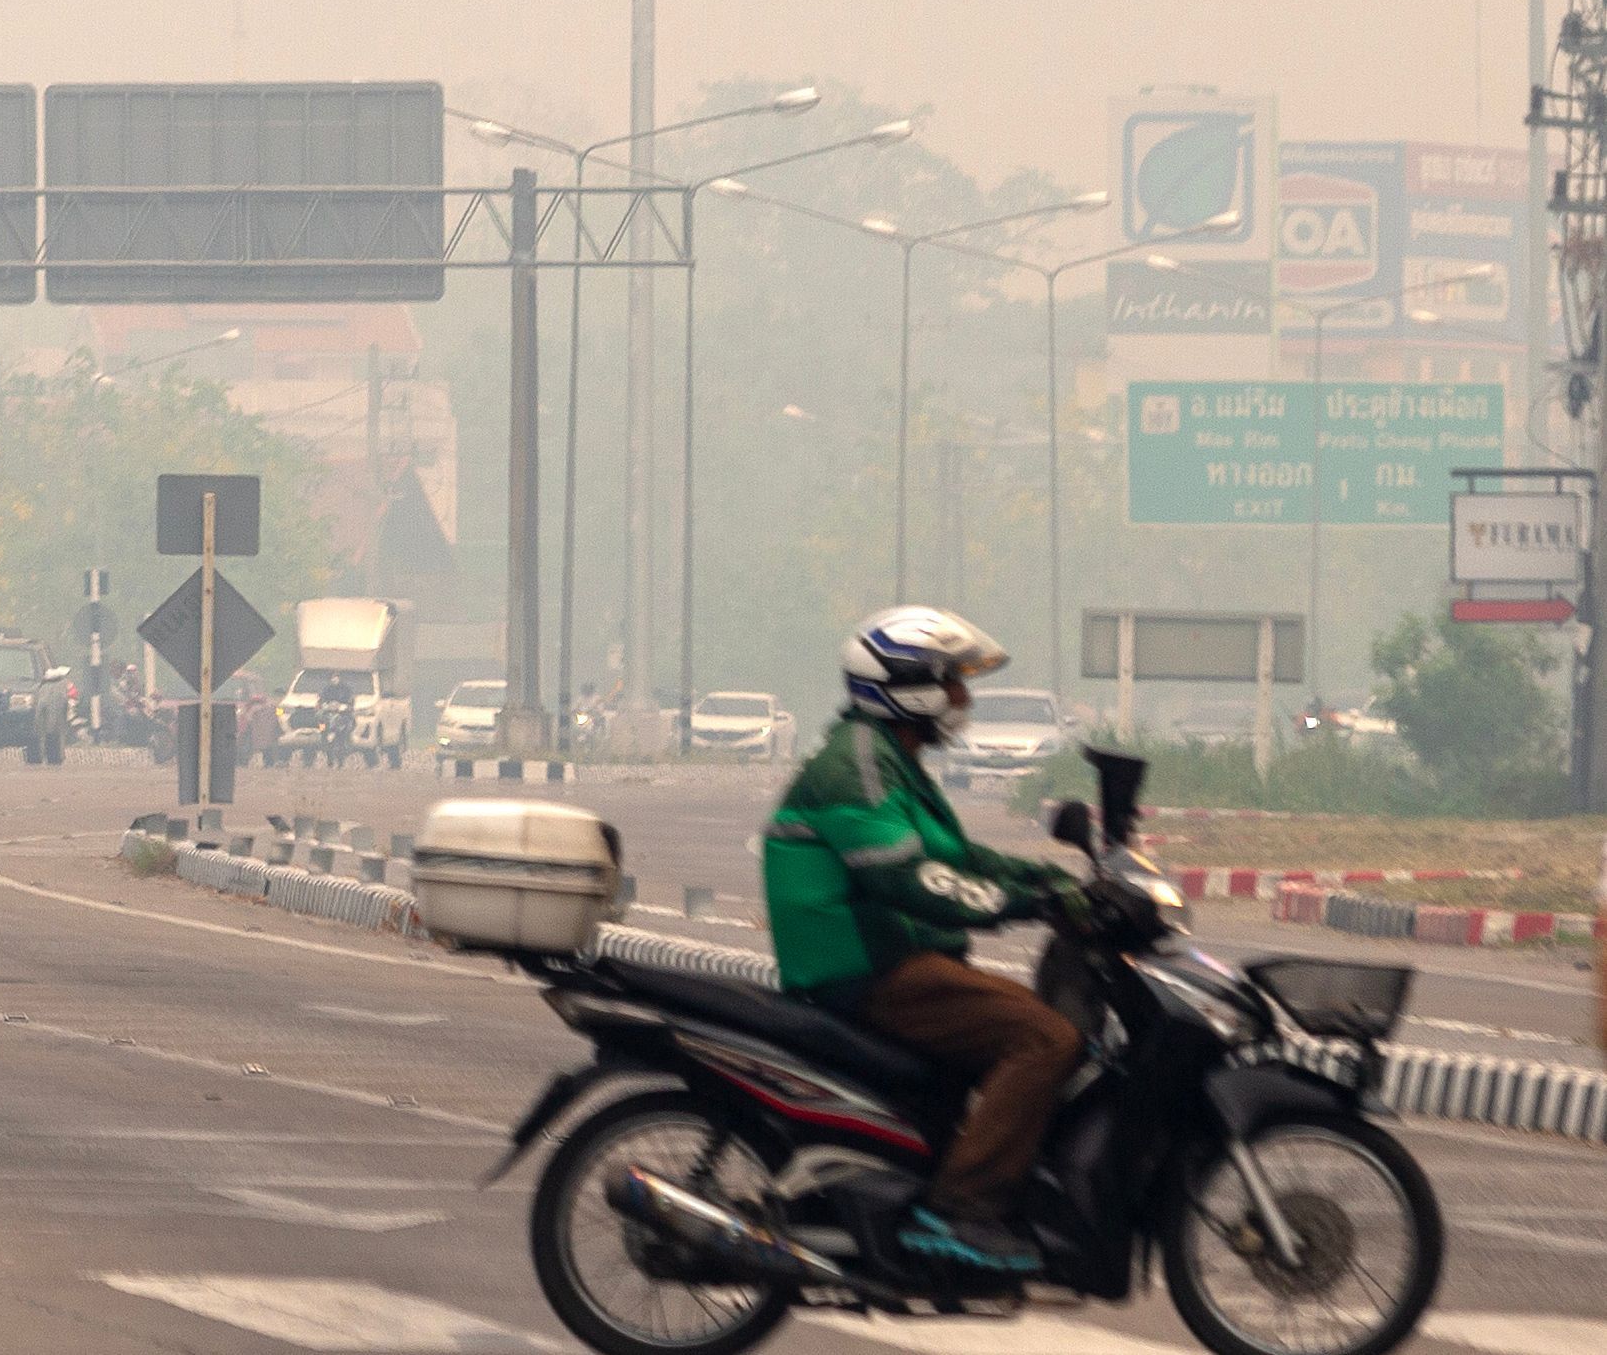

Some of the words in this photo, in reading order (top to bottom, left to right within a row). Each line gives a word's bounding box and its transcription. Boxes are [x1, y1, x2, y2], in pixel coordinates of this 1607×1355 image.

[1278, 208, 1366, 255] OA
[1111, 292, 1266, 321] Inthanin
[1205, 461, 1313, 488] ทางออก
